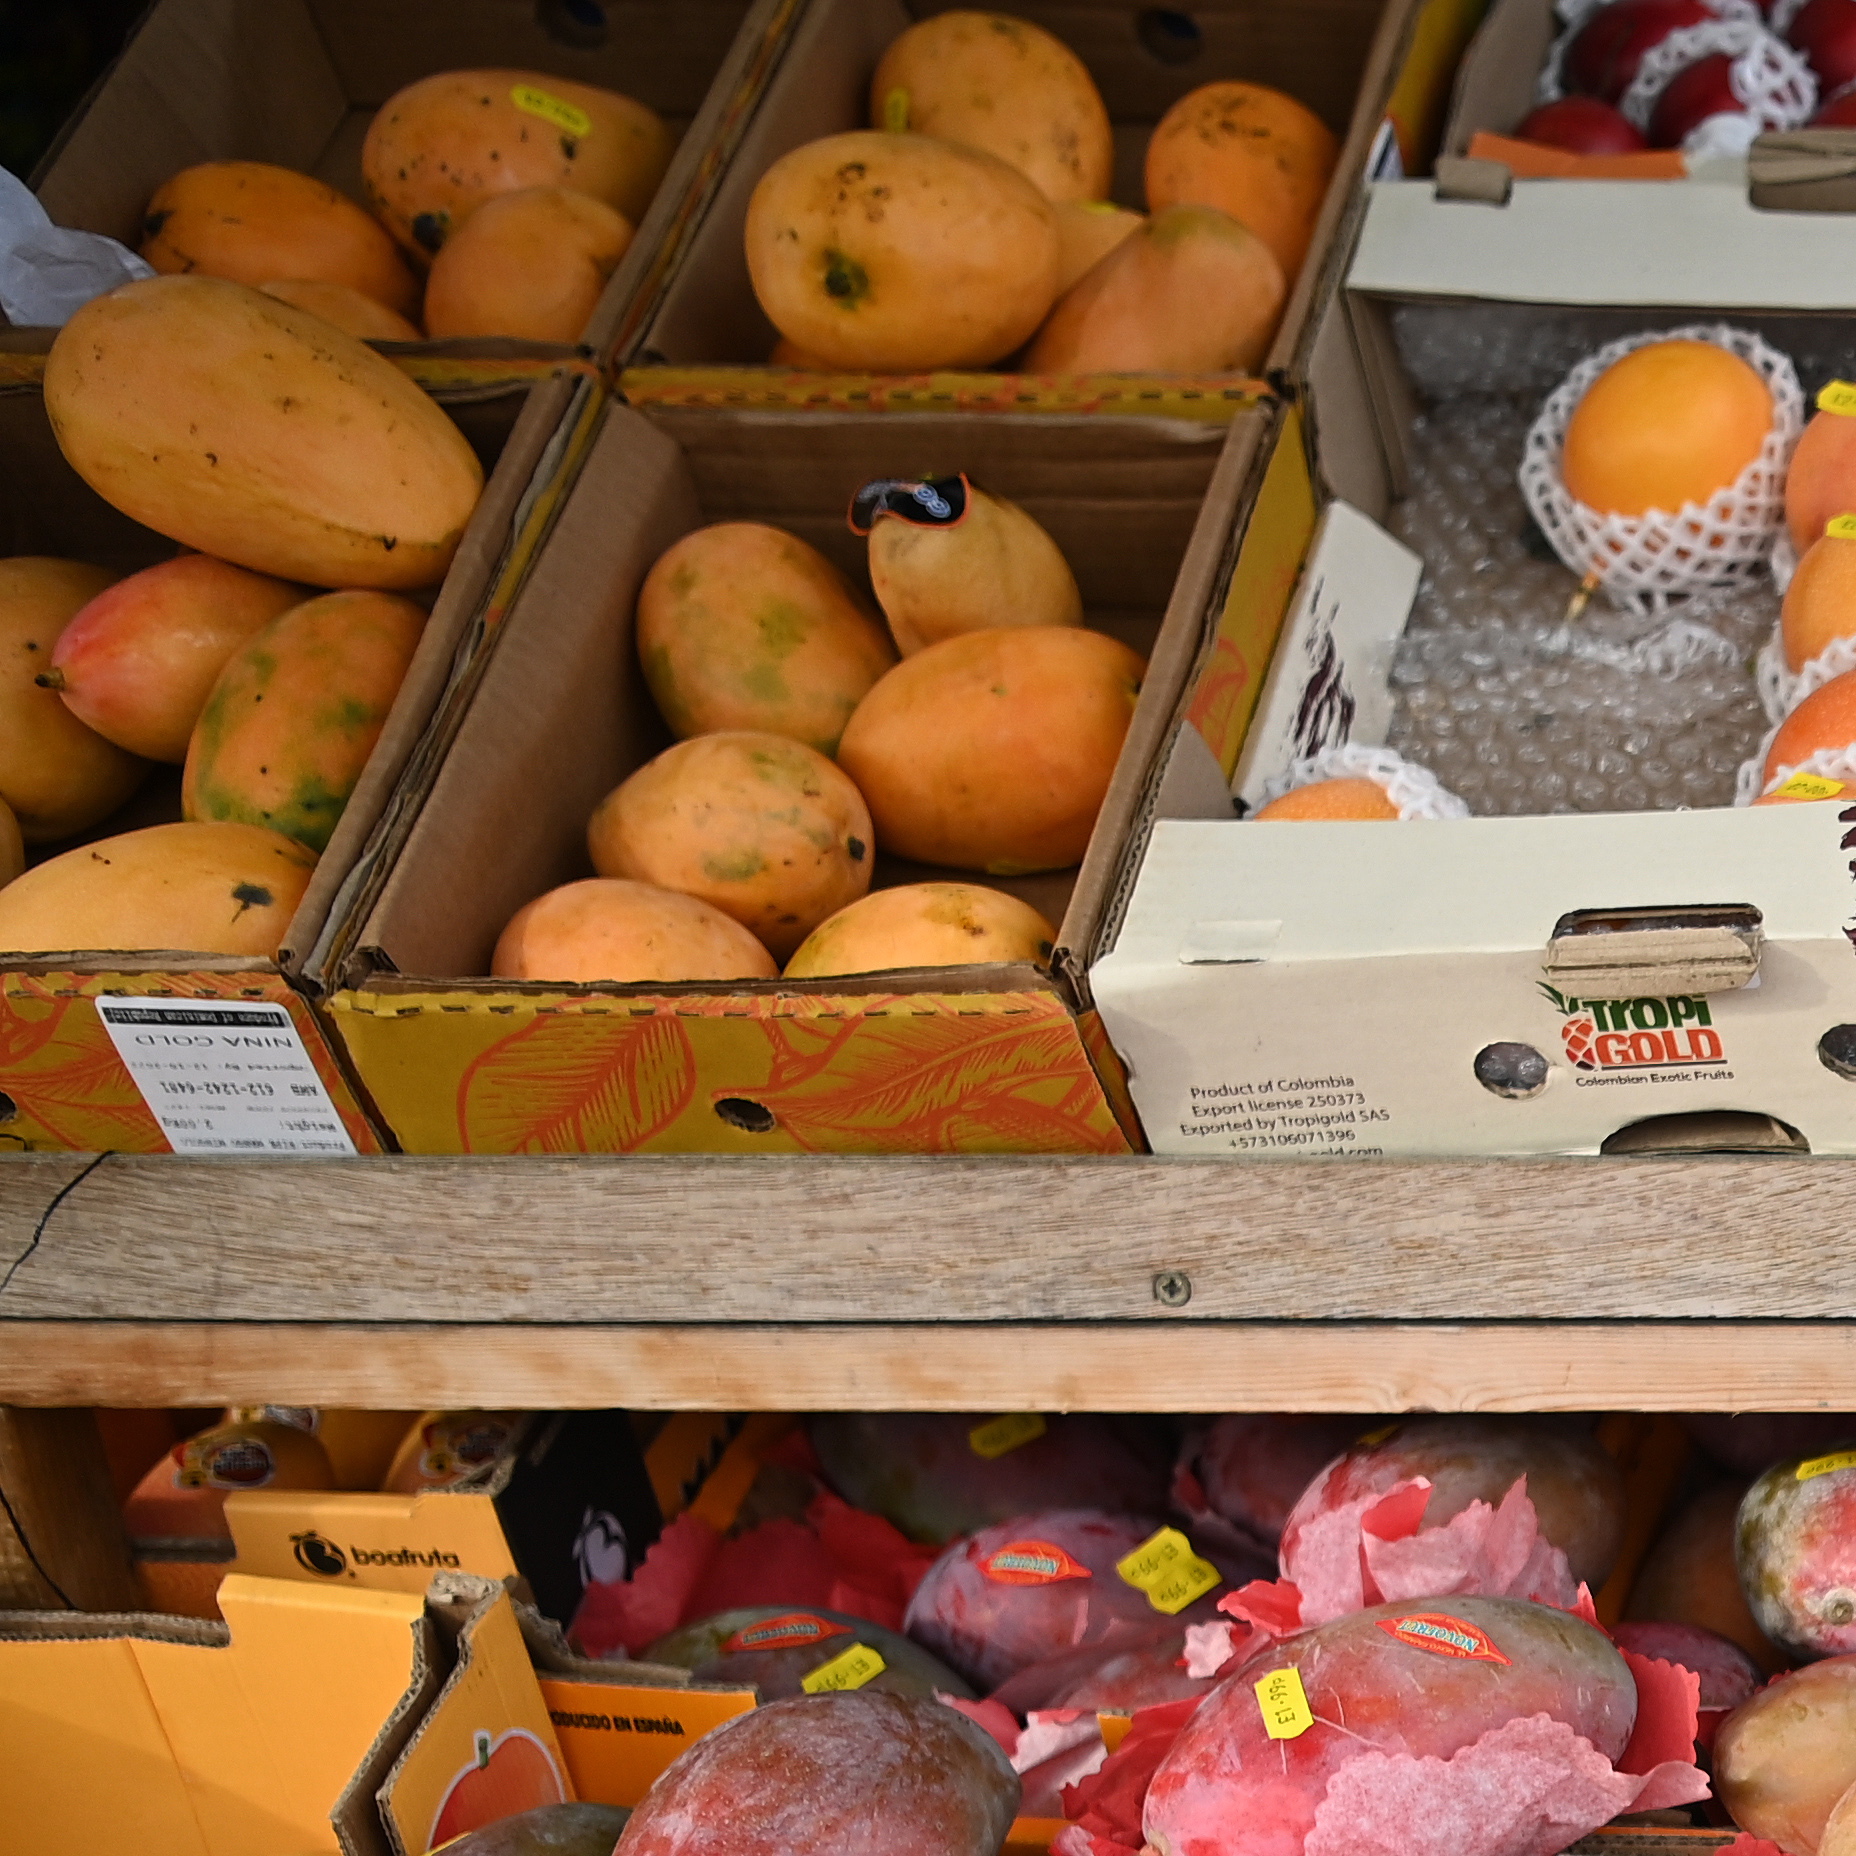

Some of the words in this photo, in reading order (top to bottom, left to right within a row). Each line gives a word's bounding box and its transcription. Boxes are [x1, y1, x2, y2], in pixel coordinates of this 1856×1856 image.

[135, 1034, 214, 1047] GOLD
[223, 1036, 293, 1049] NINA
[1595, 1028, 1724, 1065] GOLD
[1190, 1083, 1254, 1099] Product
[1258, 1080, 1273, 1093] of
[1278, 1075, 1355, 1092] Colombia
[1576, 1074, 1648, 1087] Colombian
[1650, 1072, 1692, 1084] Exotic
[1694, 1069, 1735, 1081] Fruits
[1192, 1102, 1245, 1118] Export
[1249, 1098, 1304, 1113] license
[1306, 1093, 1366, 1108] 250373
[1180, 1118, 1253, 1137] Exported
[1256, 1117, 1277, 1132] by
[1278, 1111, 1356, 1129] Tropigold
[1360, 1109, 1391, 1122] SAS
[1230, 1129, 1356, 1149] +573106071396
[350, 1546, 461, 1568] boafruta
